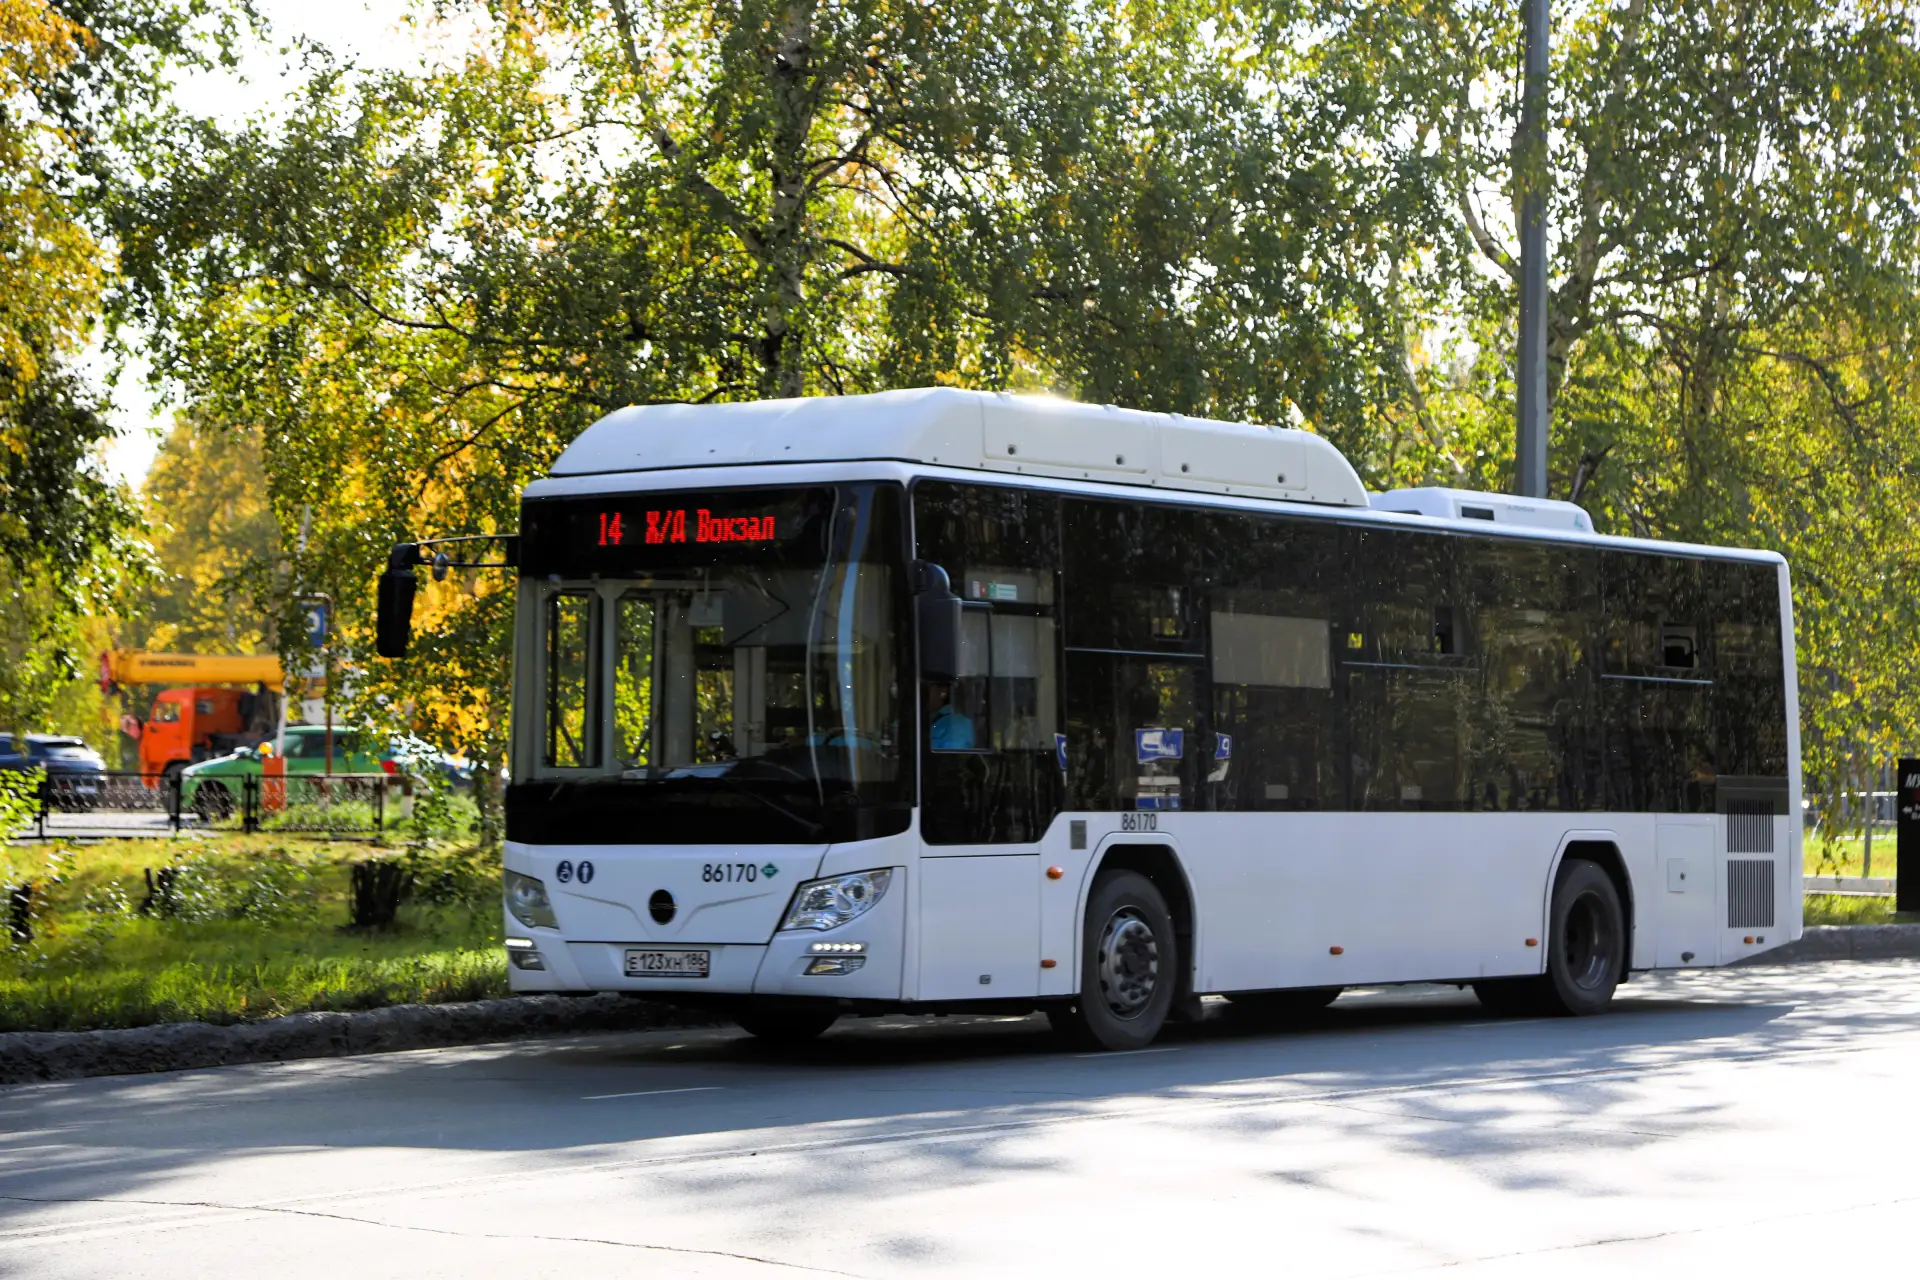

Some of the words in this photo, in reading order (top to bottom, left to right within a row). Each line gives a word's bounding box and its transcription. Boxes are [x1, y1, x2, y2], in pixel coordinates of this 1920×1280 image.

[598, 512, 623, 546] 14
[696, 508, 775, 543] Вокзал
[1121, 814, 1157, 830] 86170
[702, 863, 757, 883] 86170
